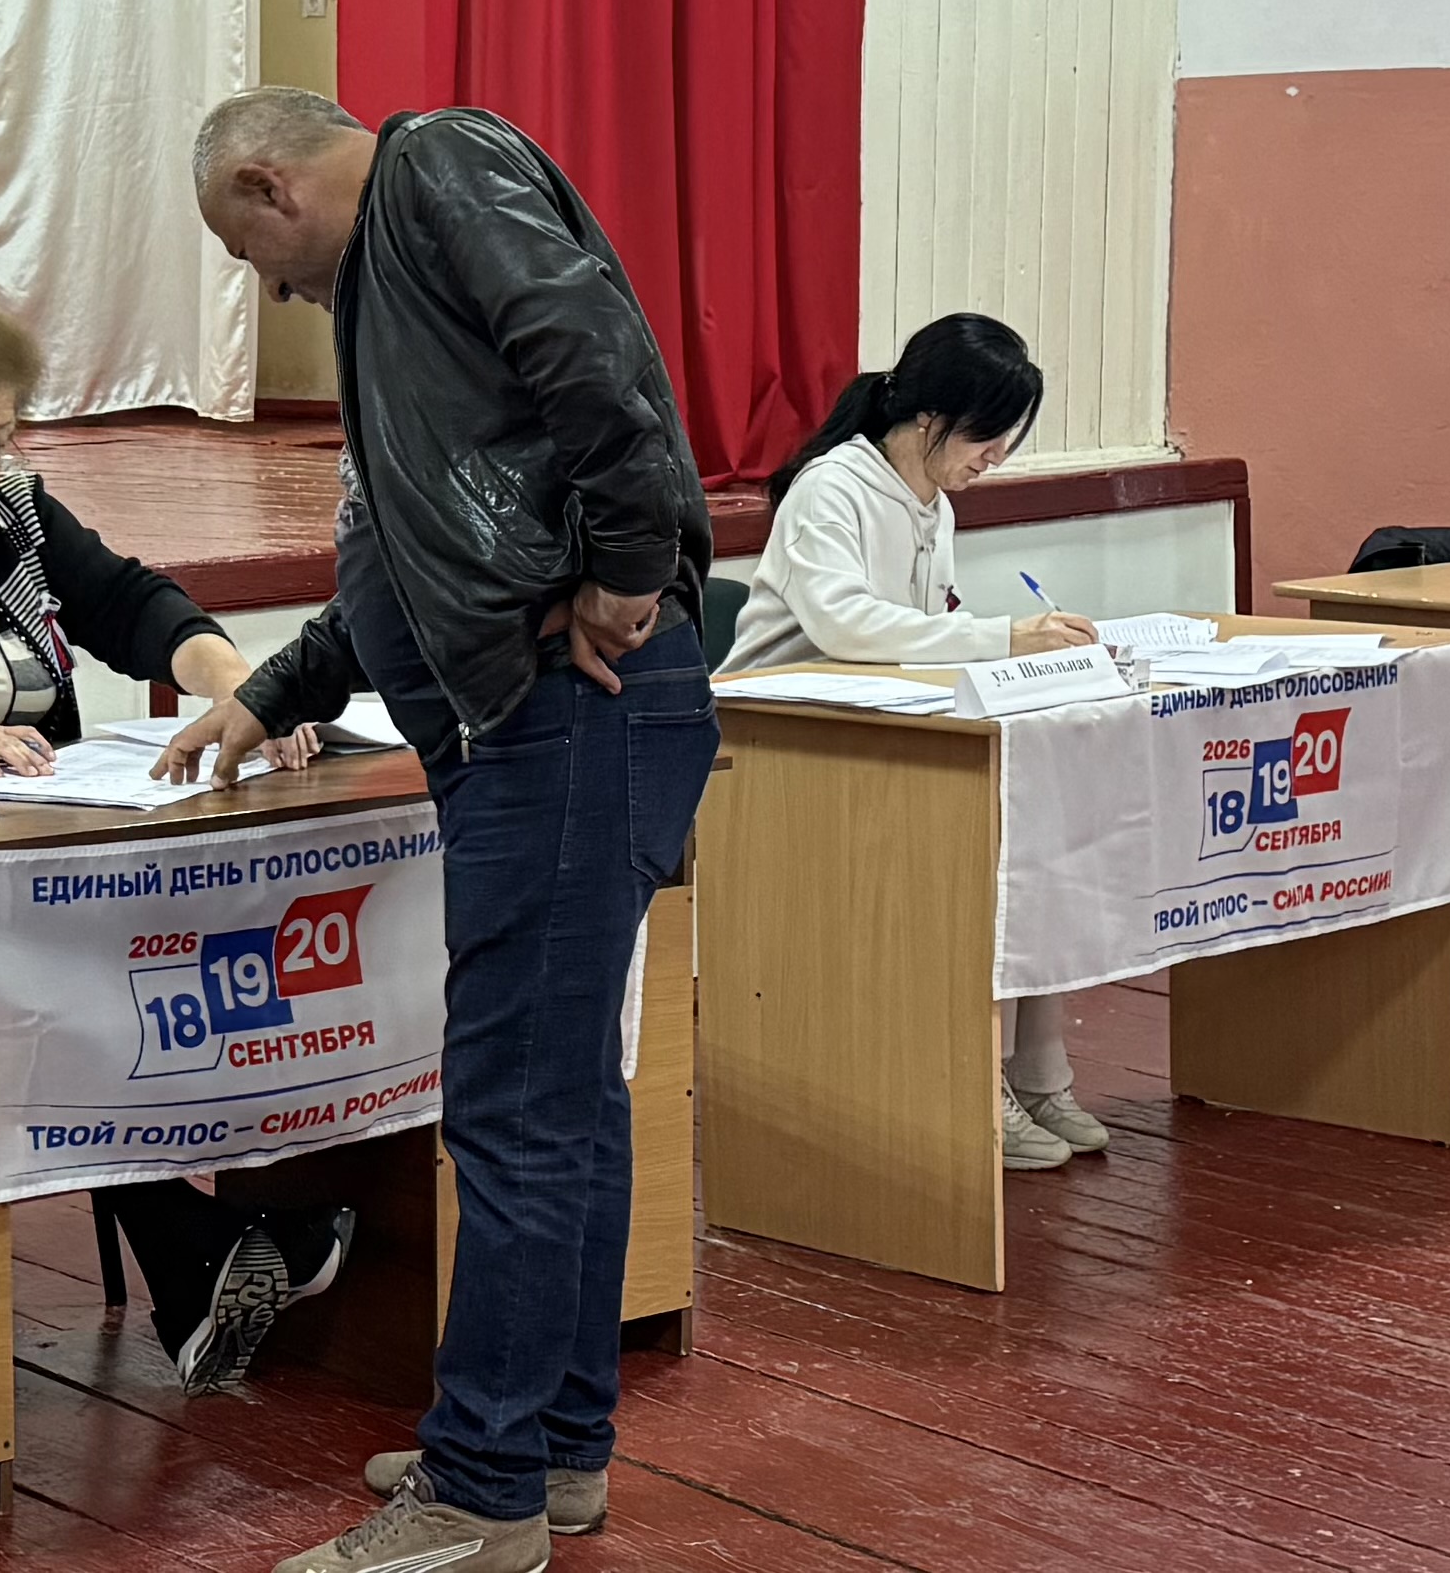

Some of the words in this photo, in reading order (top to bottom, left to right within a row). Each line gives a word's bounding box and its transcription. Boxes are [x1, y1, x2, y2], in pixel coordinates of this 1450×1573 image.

[992, 669, 1015, 687] ул.
[1017, 657, 1094, 679] Школьная
[1151, 687, 1225, 718] ЕДИНЫЙ
[1229, 683, 1274, 709] ДЕНЬ
[1275, 663, 1398, 700] ГОЛОСОВАНИЯ
[1202, 738, 1251, 762] 2026
[1207, 789, 1245, 837] 18
[1258, 759, 1292, 807] 19
[1294, 729, 1338, 777] 20
[32, 864, 162, 905] ЕДИНЫЙ
[169, 861, 243, 897] ДЕНЬ
[1202, 892, 1248, 924] ГОЛОС
[1273, 882, 1315, 911] СИЛА
[1320, 869, 1392, 903] РОССИИ!
[128, 931, 198, 959] 2026
[145, 993, 207, 1051] 18
[209, 952, 270, 1011] 19
[282, 912, 350, 973] 20
[228, 1020, 376, 1068] СЕНТЯБРЯ
[26, 1121, 115, 1151] ТВОЙ
[123, 1120, 229, 1147] ГОЛОС
[260, 1102, 336, 1135] СИЛА
